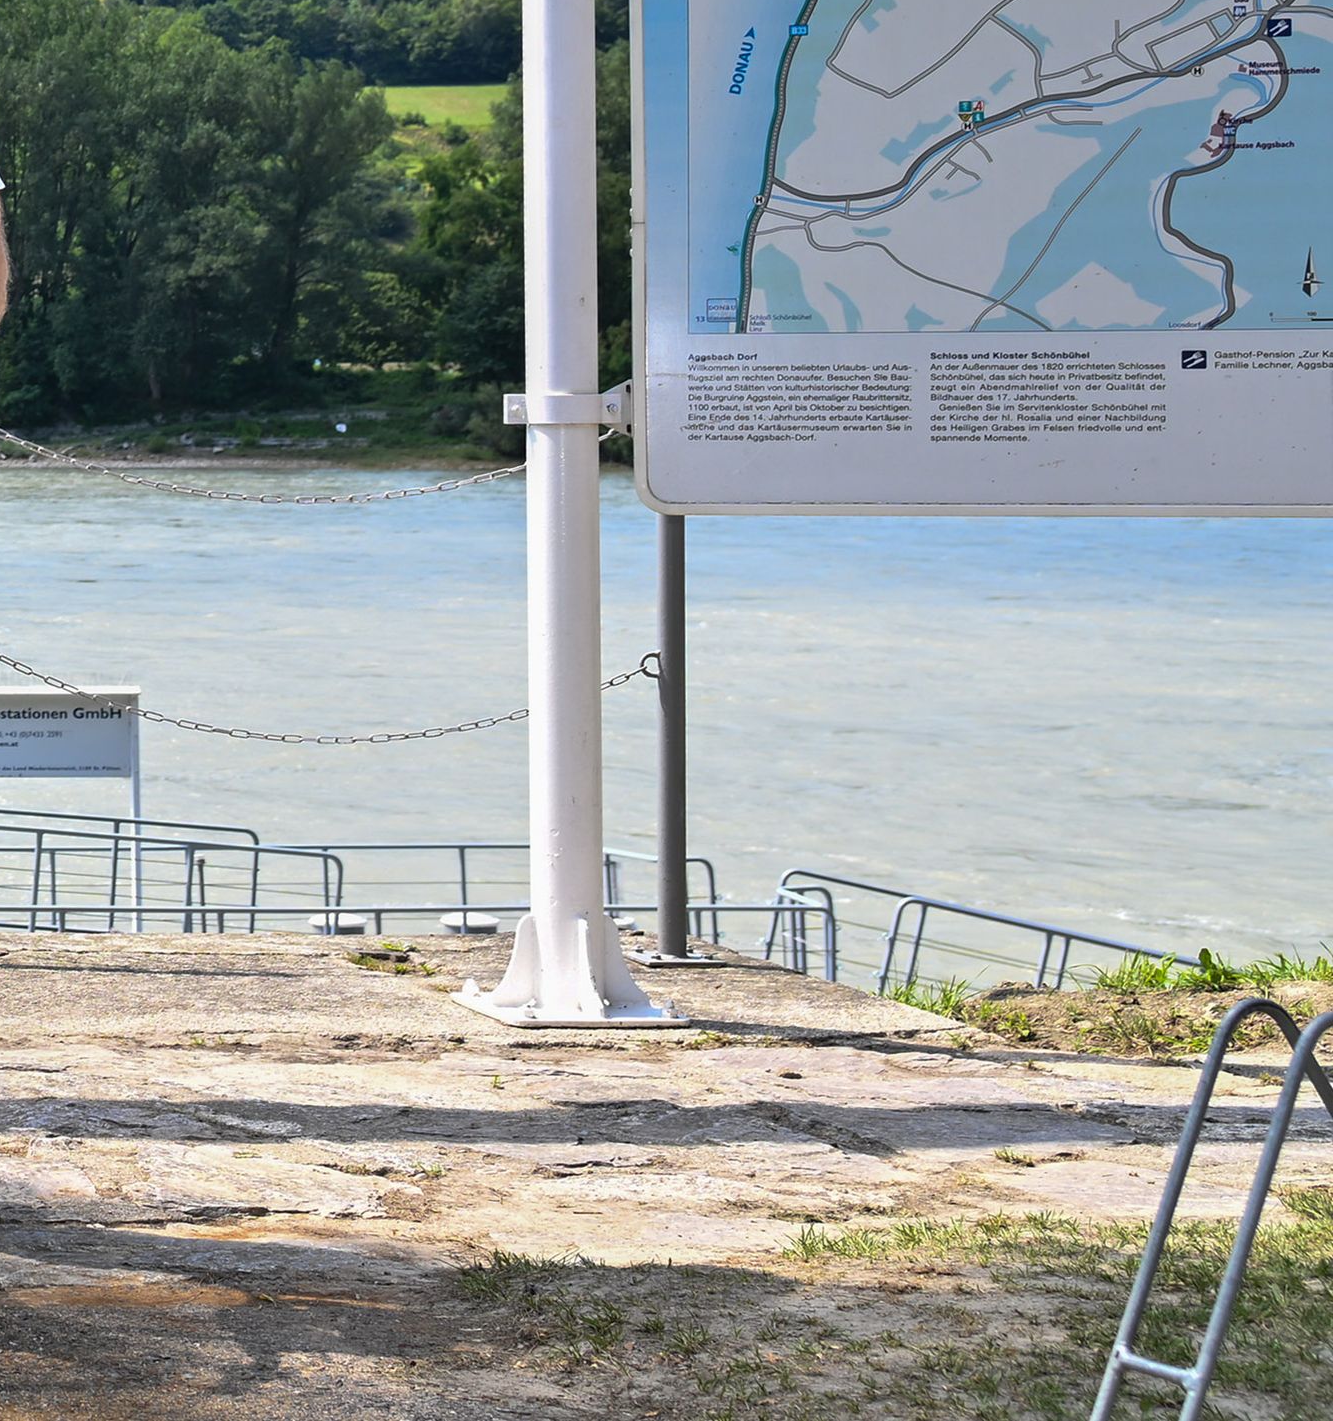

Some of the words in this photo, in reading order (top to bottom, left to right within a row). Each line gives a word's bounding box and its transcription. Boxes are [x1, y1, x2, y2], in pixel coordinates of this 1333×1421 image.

[729, 41, 755, 95] DONAU
[1255, 140, 1295, 150] Aggsbach
[688, 353, 734, 362] Aggsbach
[737, 353, 757, 361] Dorf
[1214, 350, 1295, 359] Gasthof-Pension
[688, 363, 740, 371] Willkommen
[742, 363, 749, 371] in
[791, 363, 830, 371] beliebten
[833, 363, 870, 371] Urlaubs-
[872, 363, 889, 371] und
[891, 363, 912, 371] Aus-
[930, 362, 942, 370] An
[945, 362, 960, 370] der
[962, 362, 1019, 370] Außenmauer
[1021, 362, 1038, 370] des
[1042, 362, 1064, 370] 1820
[1066, 362, 1115, 370] errichteten
[1118, 362, 1165, 370] Schlosses
[1214, 361, 1249, 369] Familie
[1252, 361, 1294, 370] Lechner,
[742, 373, 774, 381] rechten
[777, 373, 824, 381] Donauufer.
[827, 373, 871, 381] Besuchen
[873, 373, 888, 381] Sie
[891, 373, 912, 381] Bau-
[930, 373, 986, 382] Schönbühel,
[1125, 373, 1165, 382] befindet,
[862, 384, 912, 392] Bedeutung:
[930, 383, 956, 392] zeugt
[961, 383, 975, 391] ein
[980, 383, 1058, 391] Abendmahlrelief
[1085, 383, 1101, 391] der
[1106, 383, 1145, 392] Qualität
[1150, 383, 1166, 391] der
[704, 394, 744, 403] Burgruine
[746, 394, 786, 403] Aggstein,
[803, 394, 850, 403] ehemaliger
[852, 394, 912, 403] Raubrittersitz,
[711, 404, 741, 412] erbaut,
[773, 404, 792, 412] April
[859, 404, 912, 412] besichtigen.
[1105, 414, 1166, 423] Nachbildung
[930, 424, 947, 432] des
[951, 424, 988, 433] Heiligen
[991, 424, 1025, 432] Grabes
[1029, 424, 1040, 432] im
[1044, 424, 1074, 432] Felsen
[1078, 424, 1121, 432] friedvolle
[1125, 424, 1143, 432] und
[1147, 424, 1166, 432] ent-
[747, 434, 816, 442] Aggsbach-Dorf.
[931, 434, 981, 443] spannende
[984, 434, 1030, 442] Momente.
[73, 708, 122, 720] GmbH
